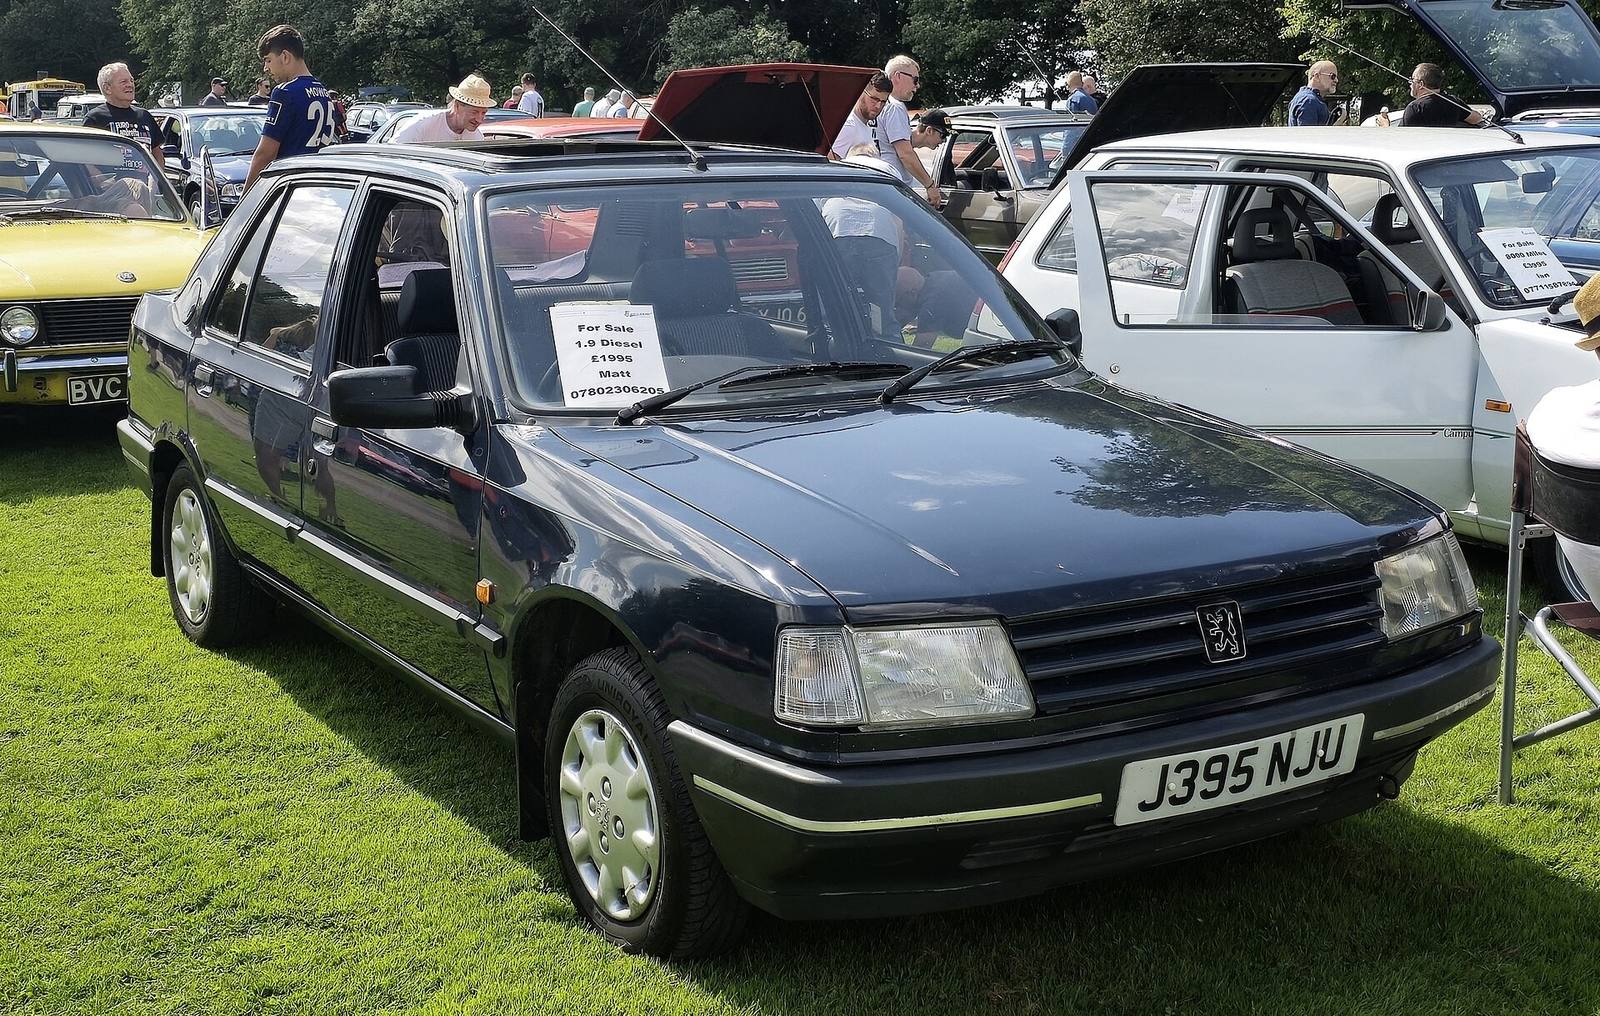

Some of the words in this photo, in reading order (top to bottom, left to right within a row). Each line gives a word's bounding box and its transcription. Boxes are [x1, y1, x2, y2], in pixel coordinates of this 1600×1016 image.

[1516, 240, 1535, 248] Sale
[577, 324, 600, 332] For
[604, 324, 634, 333] Sale
[575, 339, 596, 348] 1.9
[601, 339, 643, 348] Diesel
[591, 354, 633, 363] £1995
[599, 370, 631, 378] Matt
[71, 377, 121, 402] BVC
[570, 385, 665, 399] 07802306205
[1138, 747, 1258, 812] J395
[1266, 724, 1347, 786] NJU
